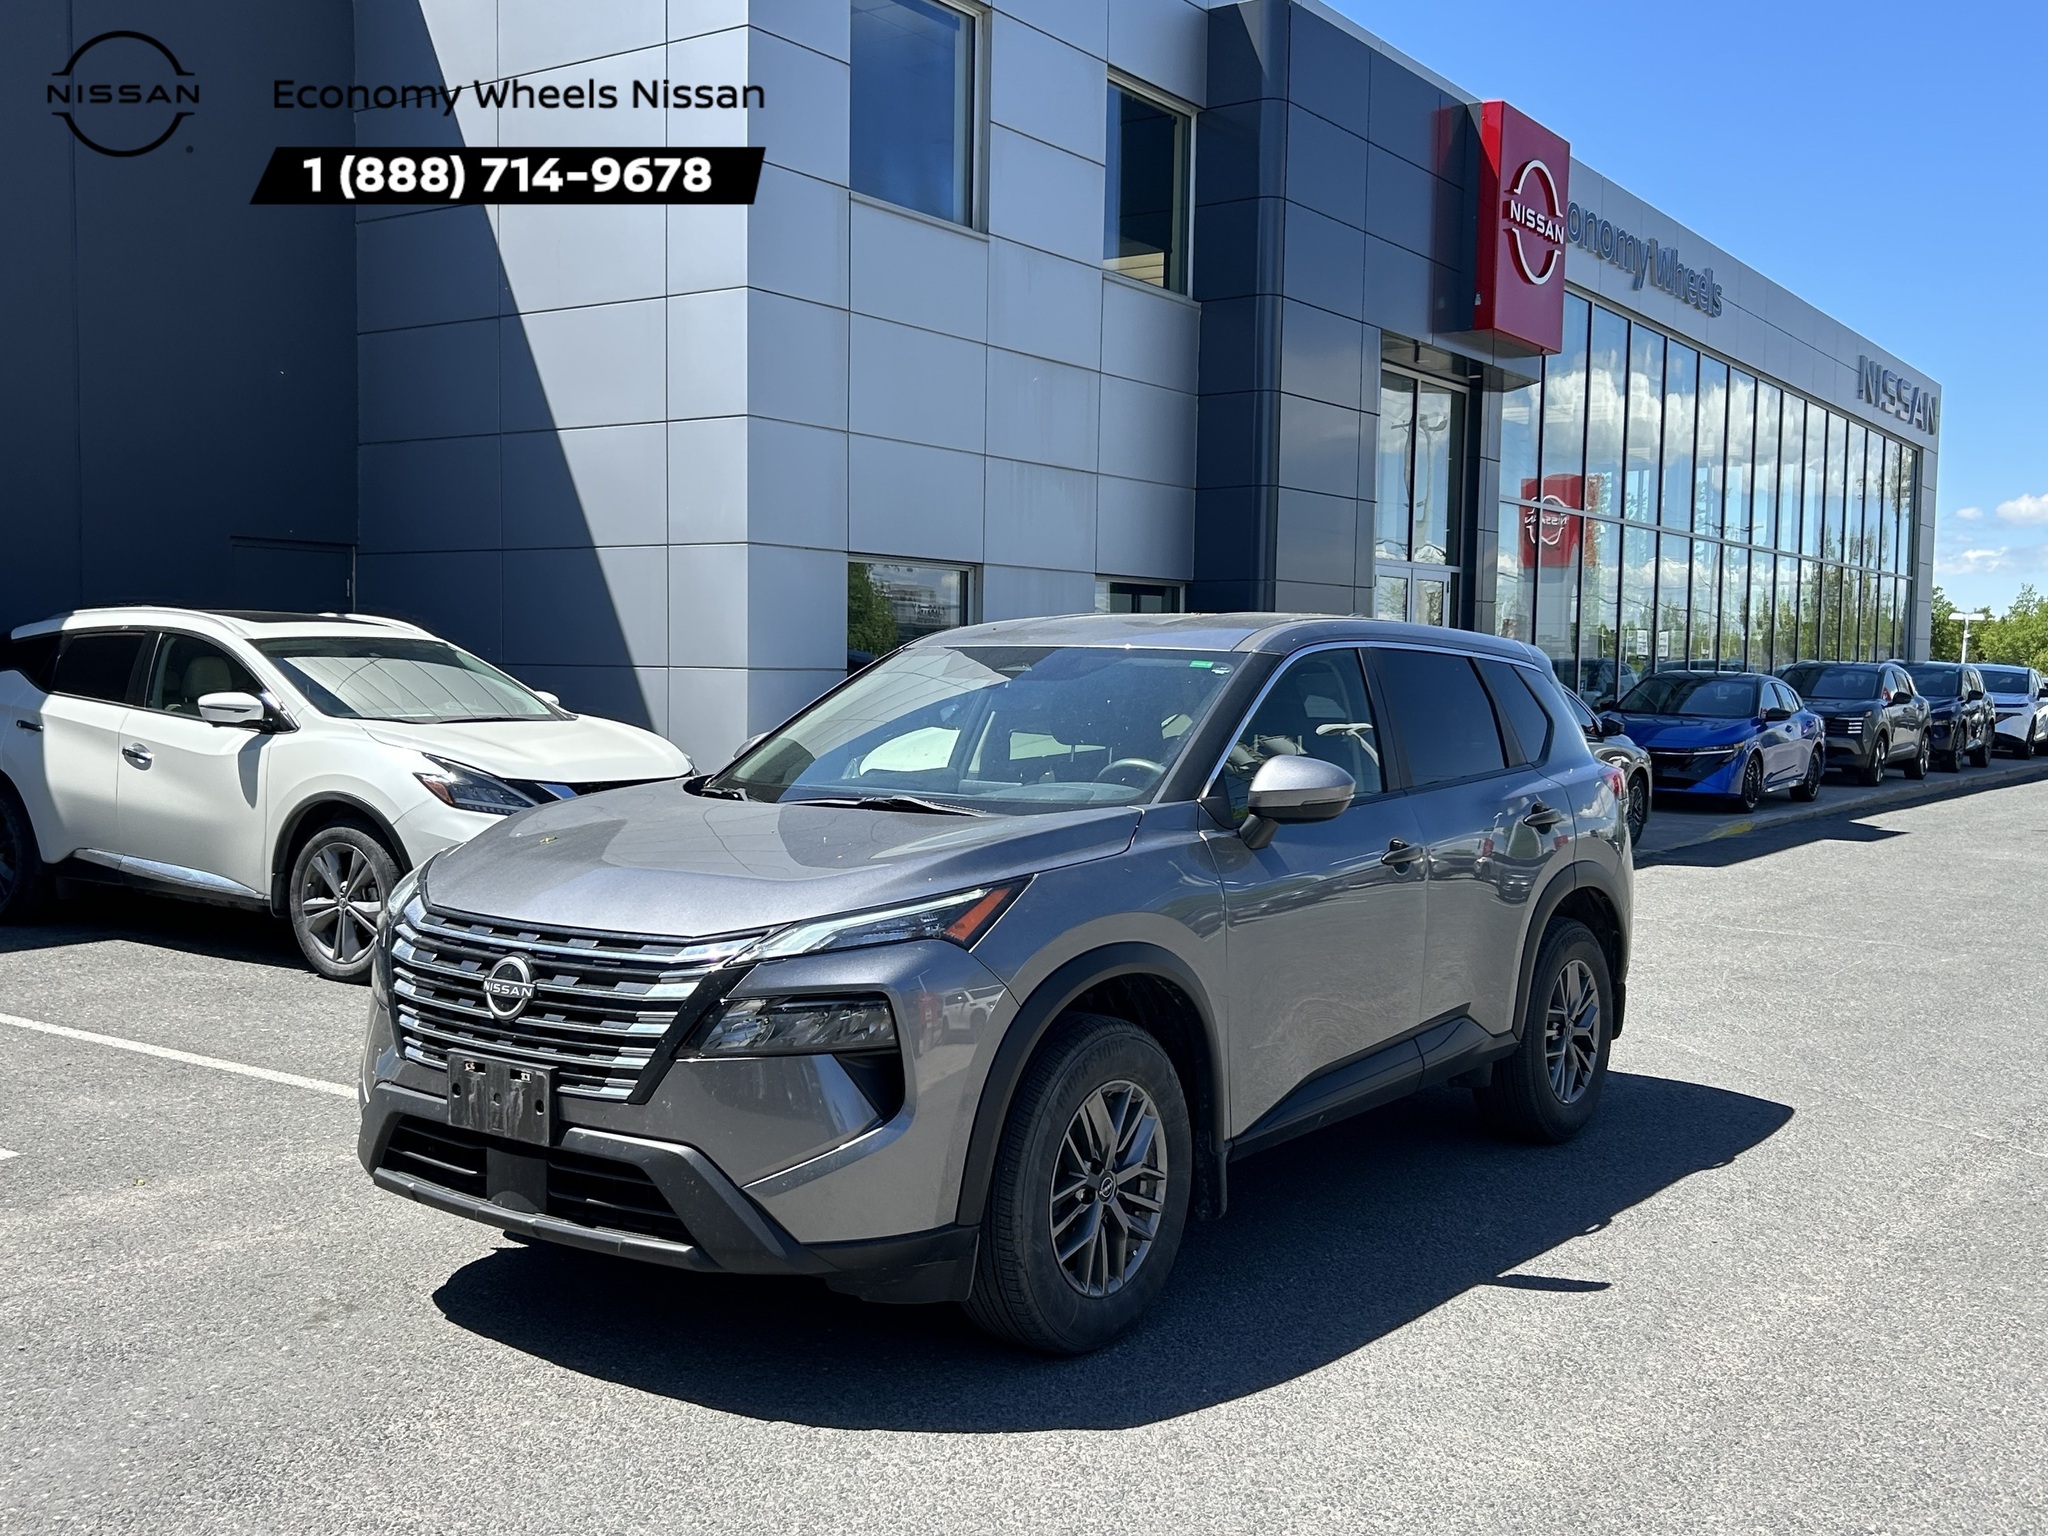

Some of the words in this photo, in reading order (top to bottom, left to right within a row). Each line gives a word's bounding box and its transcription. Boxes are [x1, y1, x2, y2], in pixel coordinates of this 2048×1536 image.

[1509, 199, 1564, 245] NISSAN
[1651, 238, 1723, 318] Wheels
[1858, 355, 1937, 435] NISSAN
[483, 980, 533, 997] NISSAN
